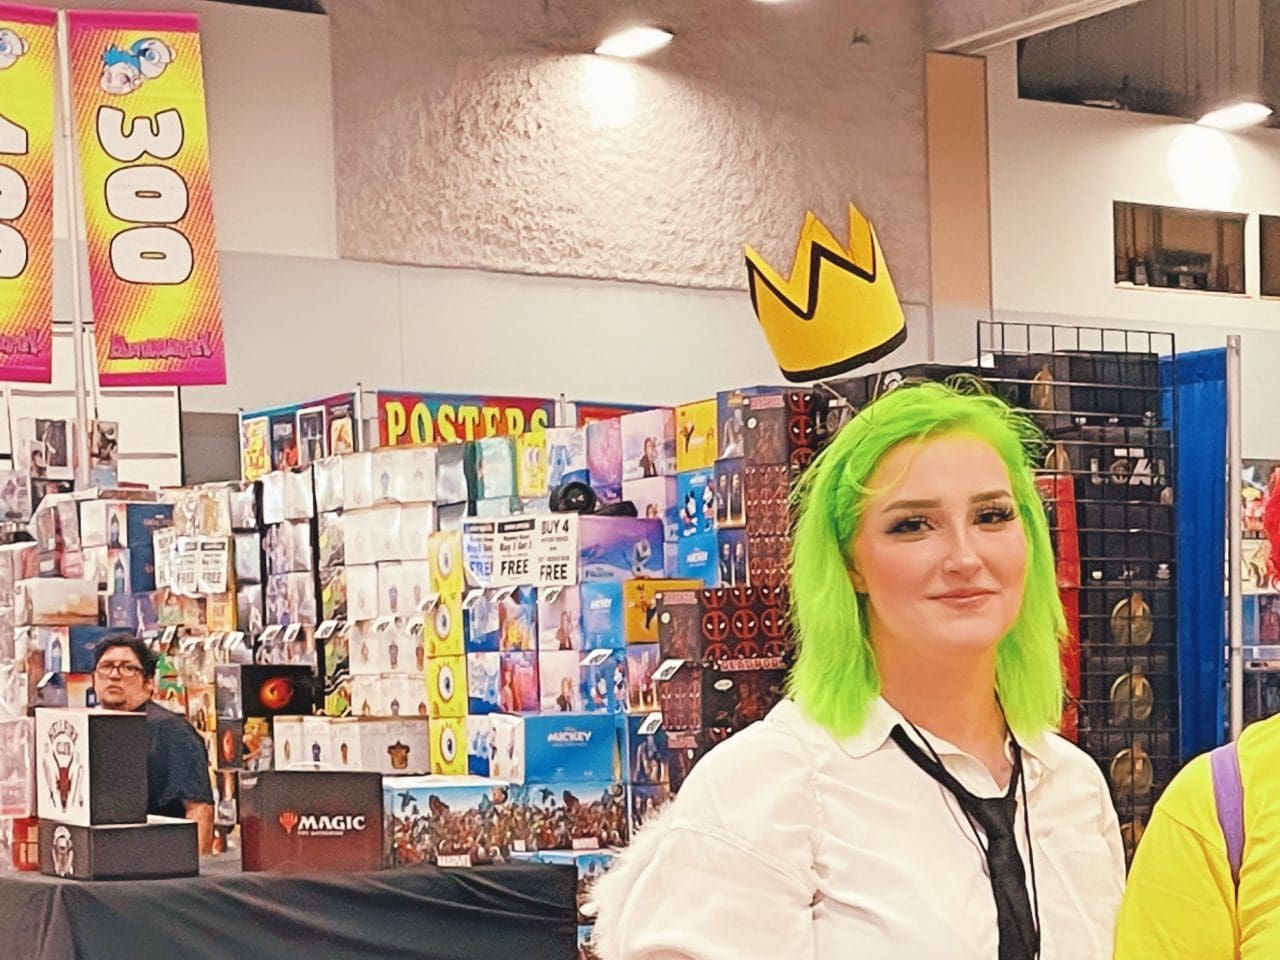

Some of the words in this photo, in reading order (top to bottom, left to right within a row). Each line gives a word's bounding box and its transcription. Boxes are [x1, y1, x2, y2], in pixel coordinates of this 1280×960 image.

[96, 104, 194, 285] 300
[541, 520, 560, 534] BUY
[562, 519, 569, 532] 4
[500, 559, 529, 576] FREE
[540, 563, 568, 581] FREE
[297, 815, 366, 831] MAGIC
